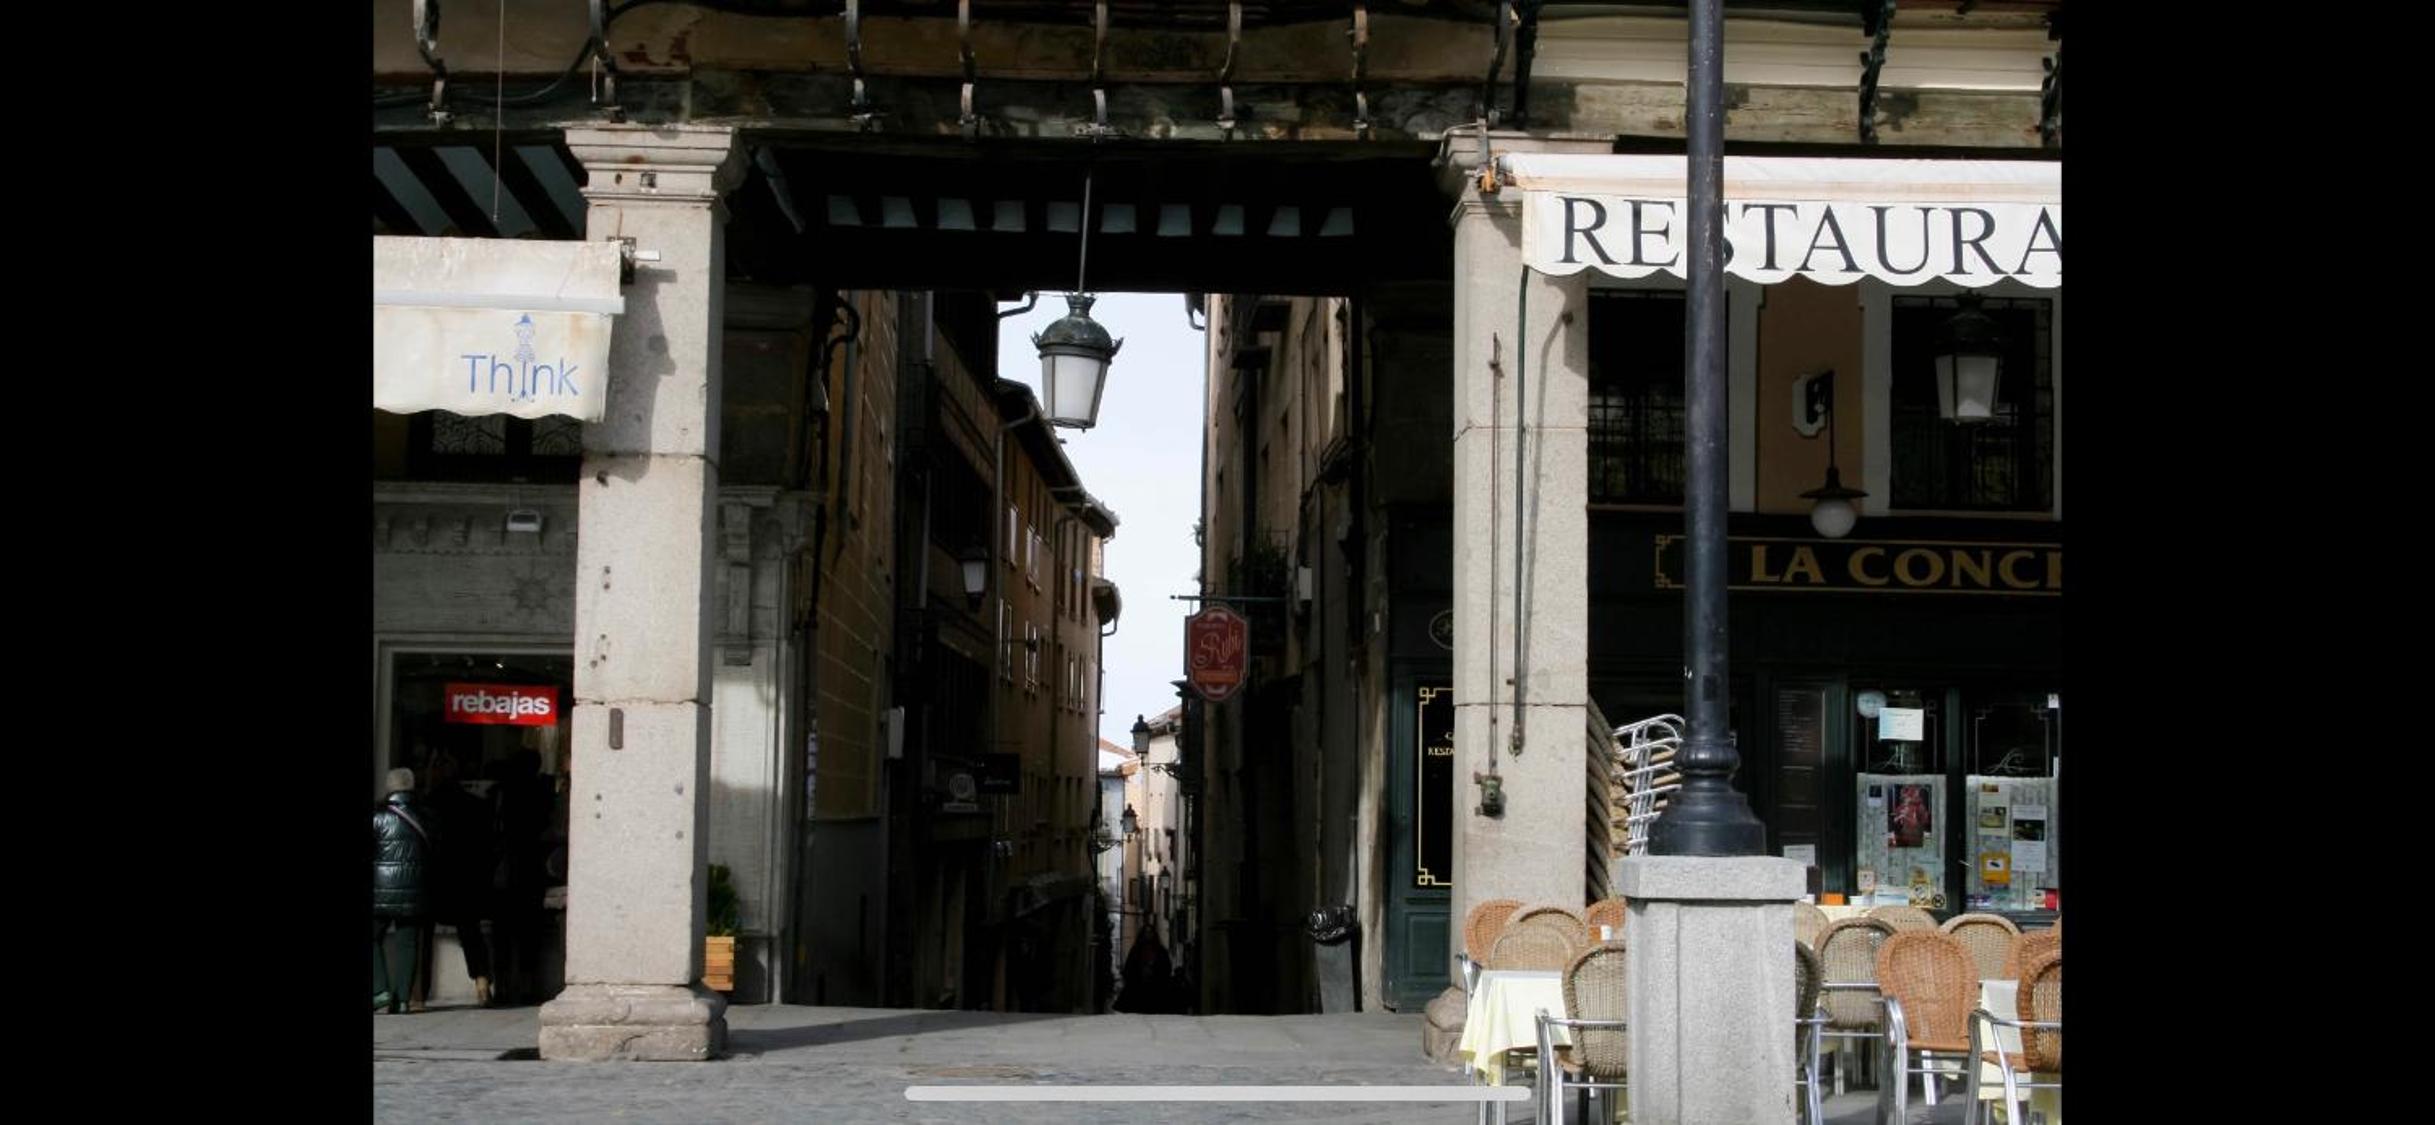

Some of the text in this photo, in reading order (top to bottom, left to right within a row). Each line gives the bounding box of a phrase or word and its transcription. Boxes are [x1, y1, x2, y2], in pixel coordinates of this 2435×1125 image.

[460, 354, 579, 397] Think
[1751, 545, 1826, 584] LA
[452, 690, 550, 720] rebajas
